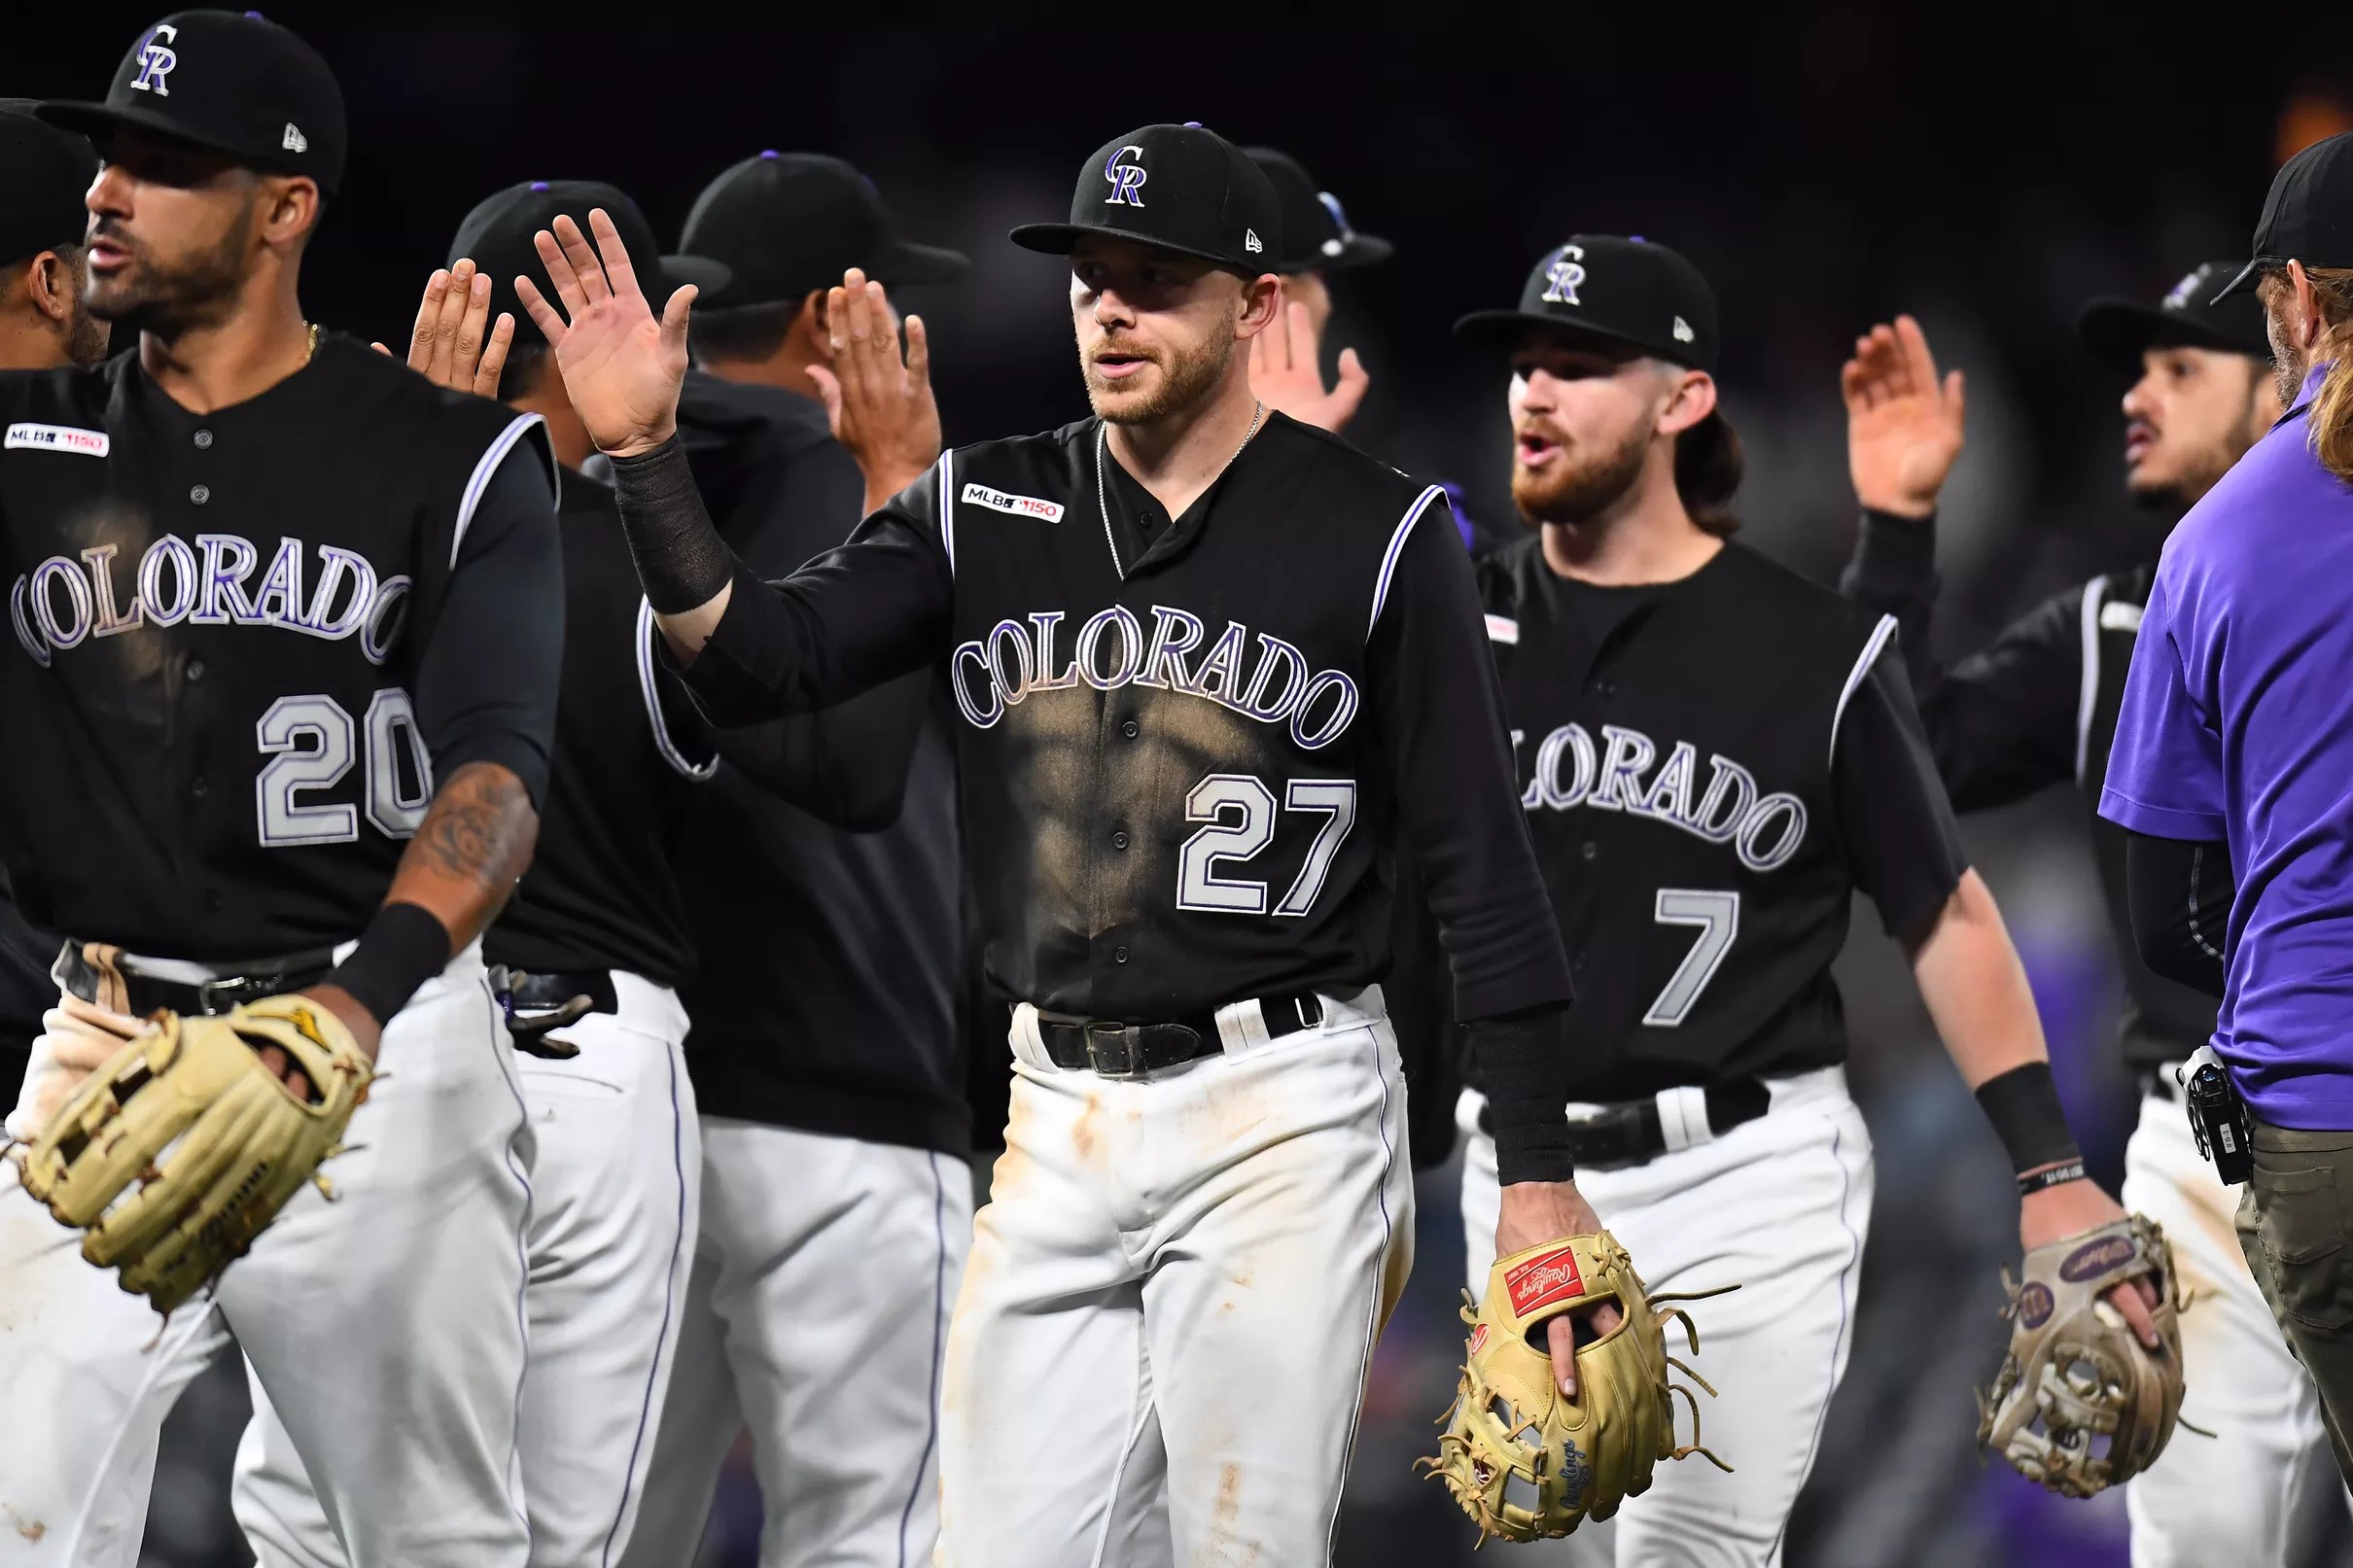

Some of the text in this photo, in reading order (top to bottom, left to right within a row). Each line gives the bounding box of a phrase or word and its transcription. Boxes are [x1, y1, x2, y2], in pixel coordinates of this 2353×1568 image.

[967, 488, 1057, 517] MLB 150
[951, 604, 1359, 749] COLORADO
[256, 686, 434, 848] 20
[1176, 774, 1356, 917] 27
[1641, 889, 1740, 1027] 7
[1517, 1264, 1570, 1301] Rawlings
[1559, 1439, 1587, 1510] Rawlings
